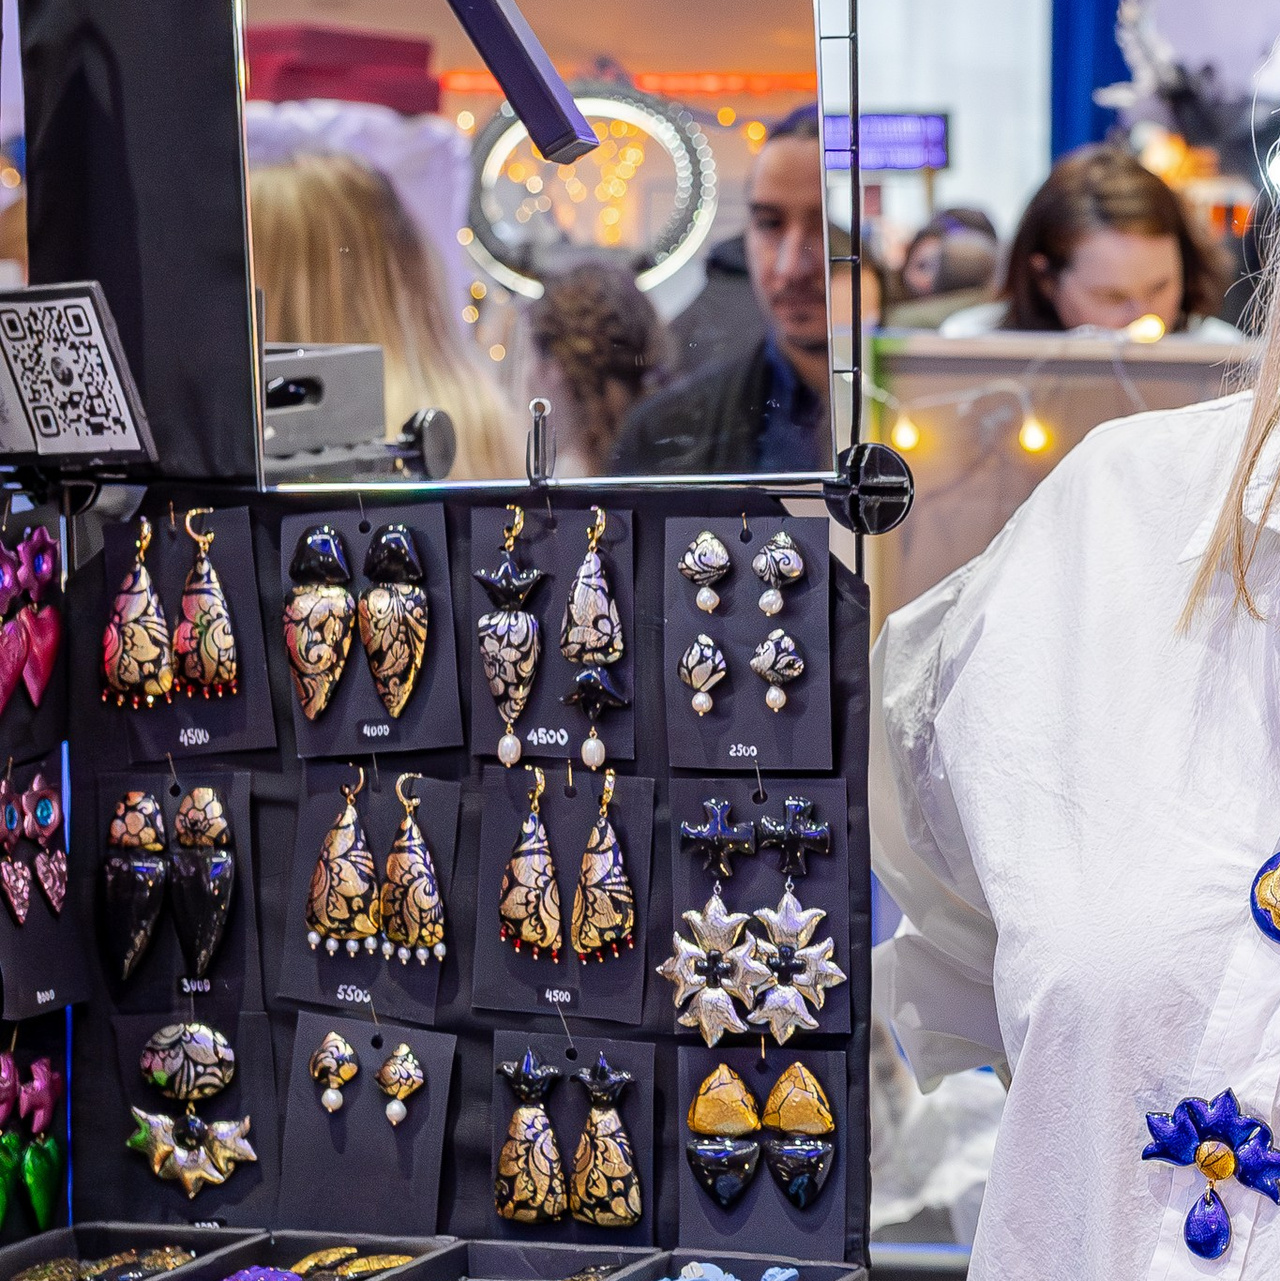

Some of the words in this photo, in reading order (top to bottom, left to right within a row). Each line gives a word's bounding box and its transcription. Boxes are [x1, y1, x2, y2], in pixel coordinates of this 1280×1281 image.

[179, 728, 210, 746] 4500
[362, 724, 390, 737] 4000
[526, 727, 569, 746] 4500
[728, 743, 758, 757] 2500
[181, 977, 211, 993] 3000
[336, 984, 371, 1003] 5500
[544, 988, 571, 1003] 4500
